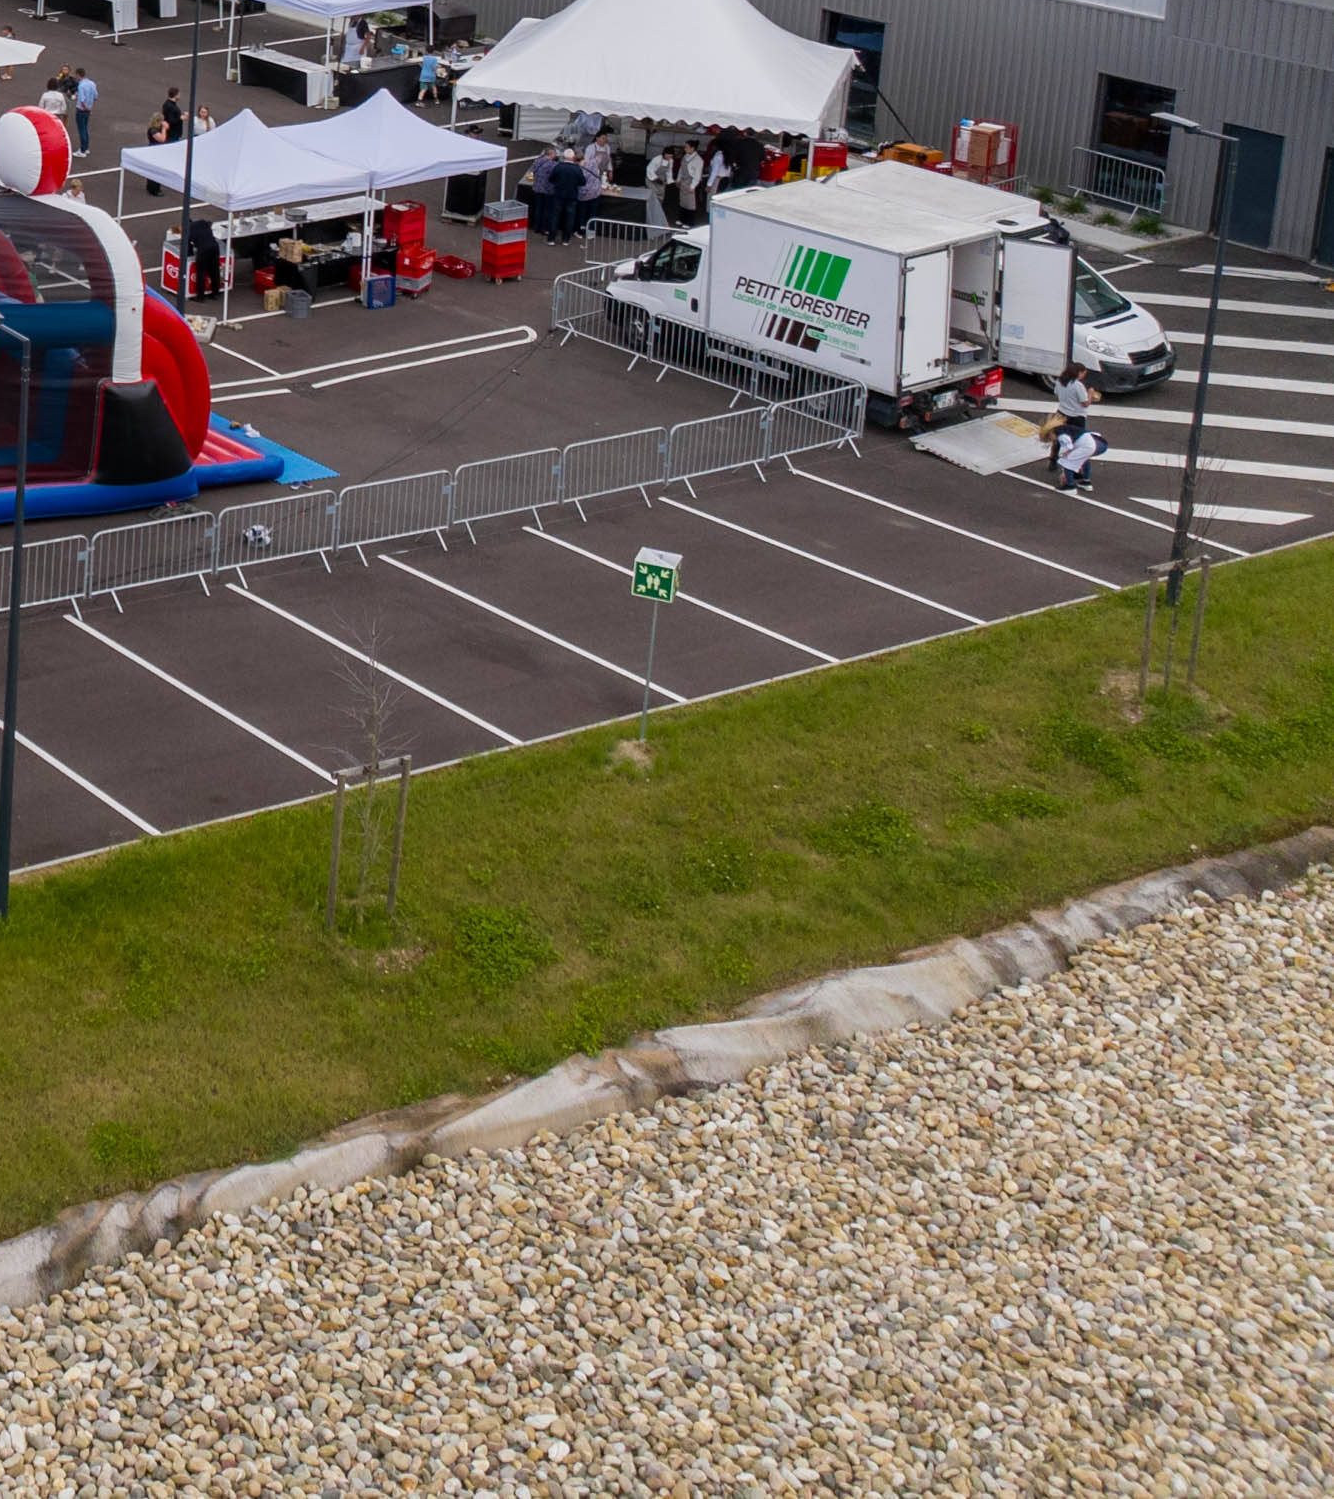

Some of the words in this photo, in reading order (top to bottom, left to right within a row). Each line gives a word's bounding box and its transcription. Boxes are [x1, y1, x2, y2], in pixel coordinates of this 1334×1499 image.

[732, 291, 765, 307] Location
[766, 300, 777, 310] de
[735, 276, 780, 300] PETIT
[780, 290, 870, 329] FORESTIER
